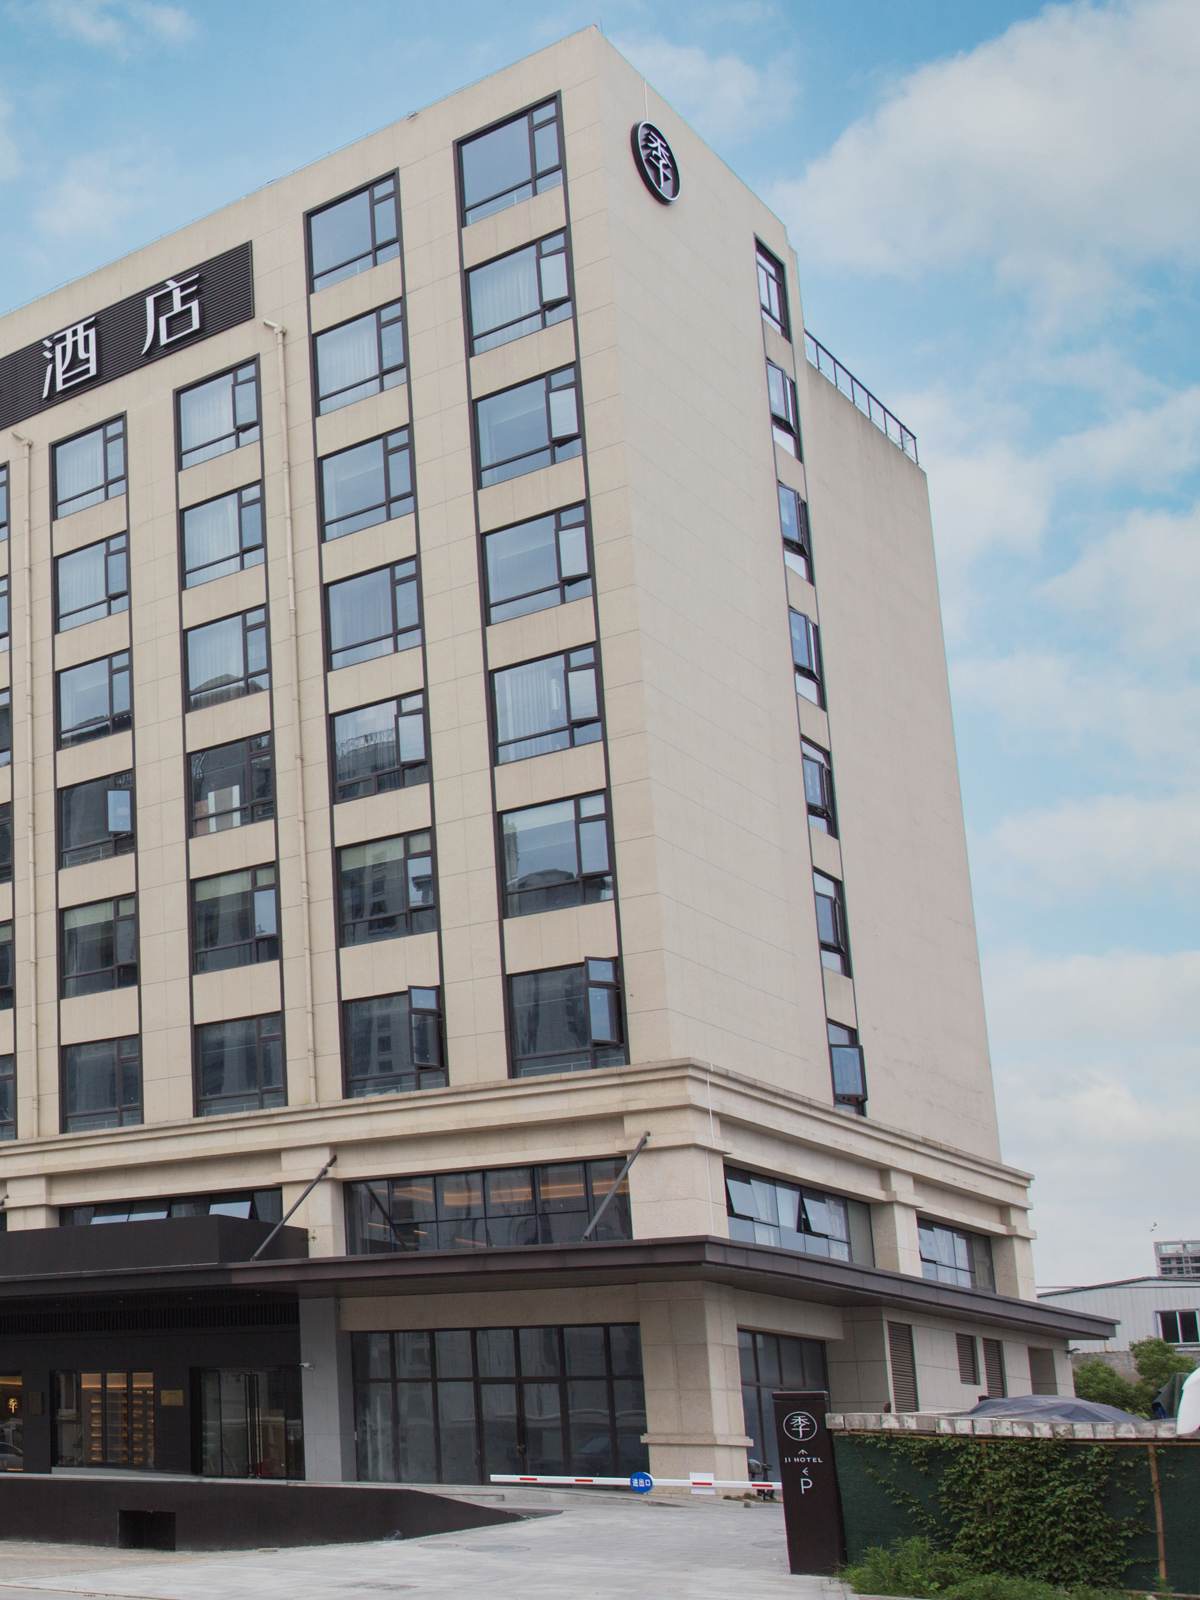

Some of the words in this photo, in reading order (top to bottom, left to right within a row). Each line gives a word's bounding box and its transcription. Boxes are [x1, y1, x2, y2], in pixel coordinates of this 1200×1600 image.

[647, 131, 673, 188] 季
[790, 1415, 810, 1439] 季
[632, 1478, 651, 1488] 进出口
[800, 1477, 813, 1495] P
